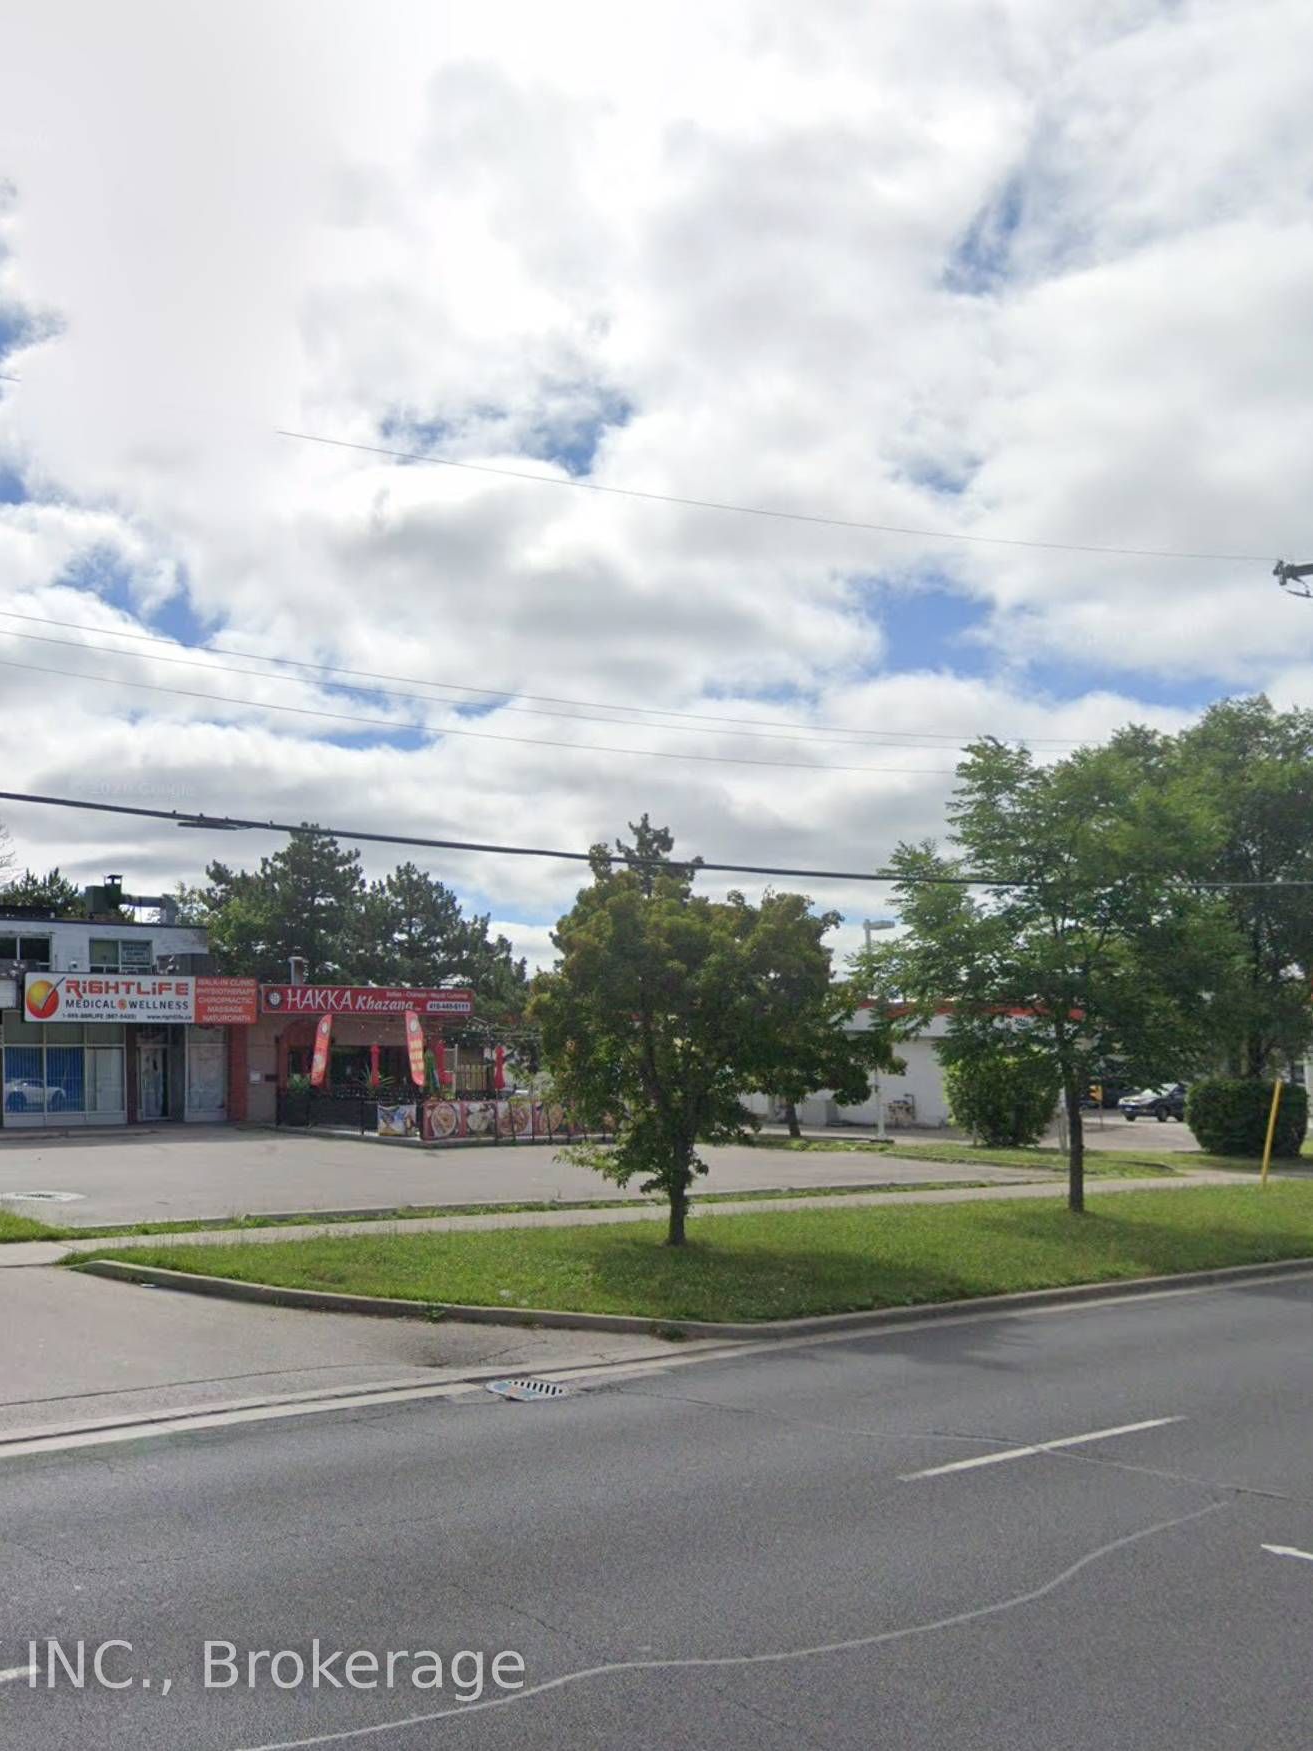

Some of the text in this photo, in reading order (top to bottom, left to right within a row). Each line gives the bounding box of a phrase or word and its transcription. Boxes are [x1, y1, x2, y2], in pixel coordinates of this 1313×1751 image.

[65, 999, 189, 1010] MEDICAL WELLNESS
[287, 988, 416, 1012] HAKKA Khazana
